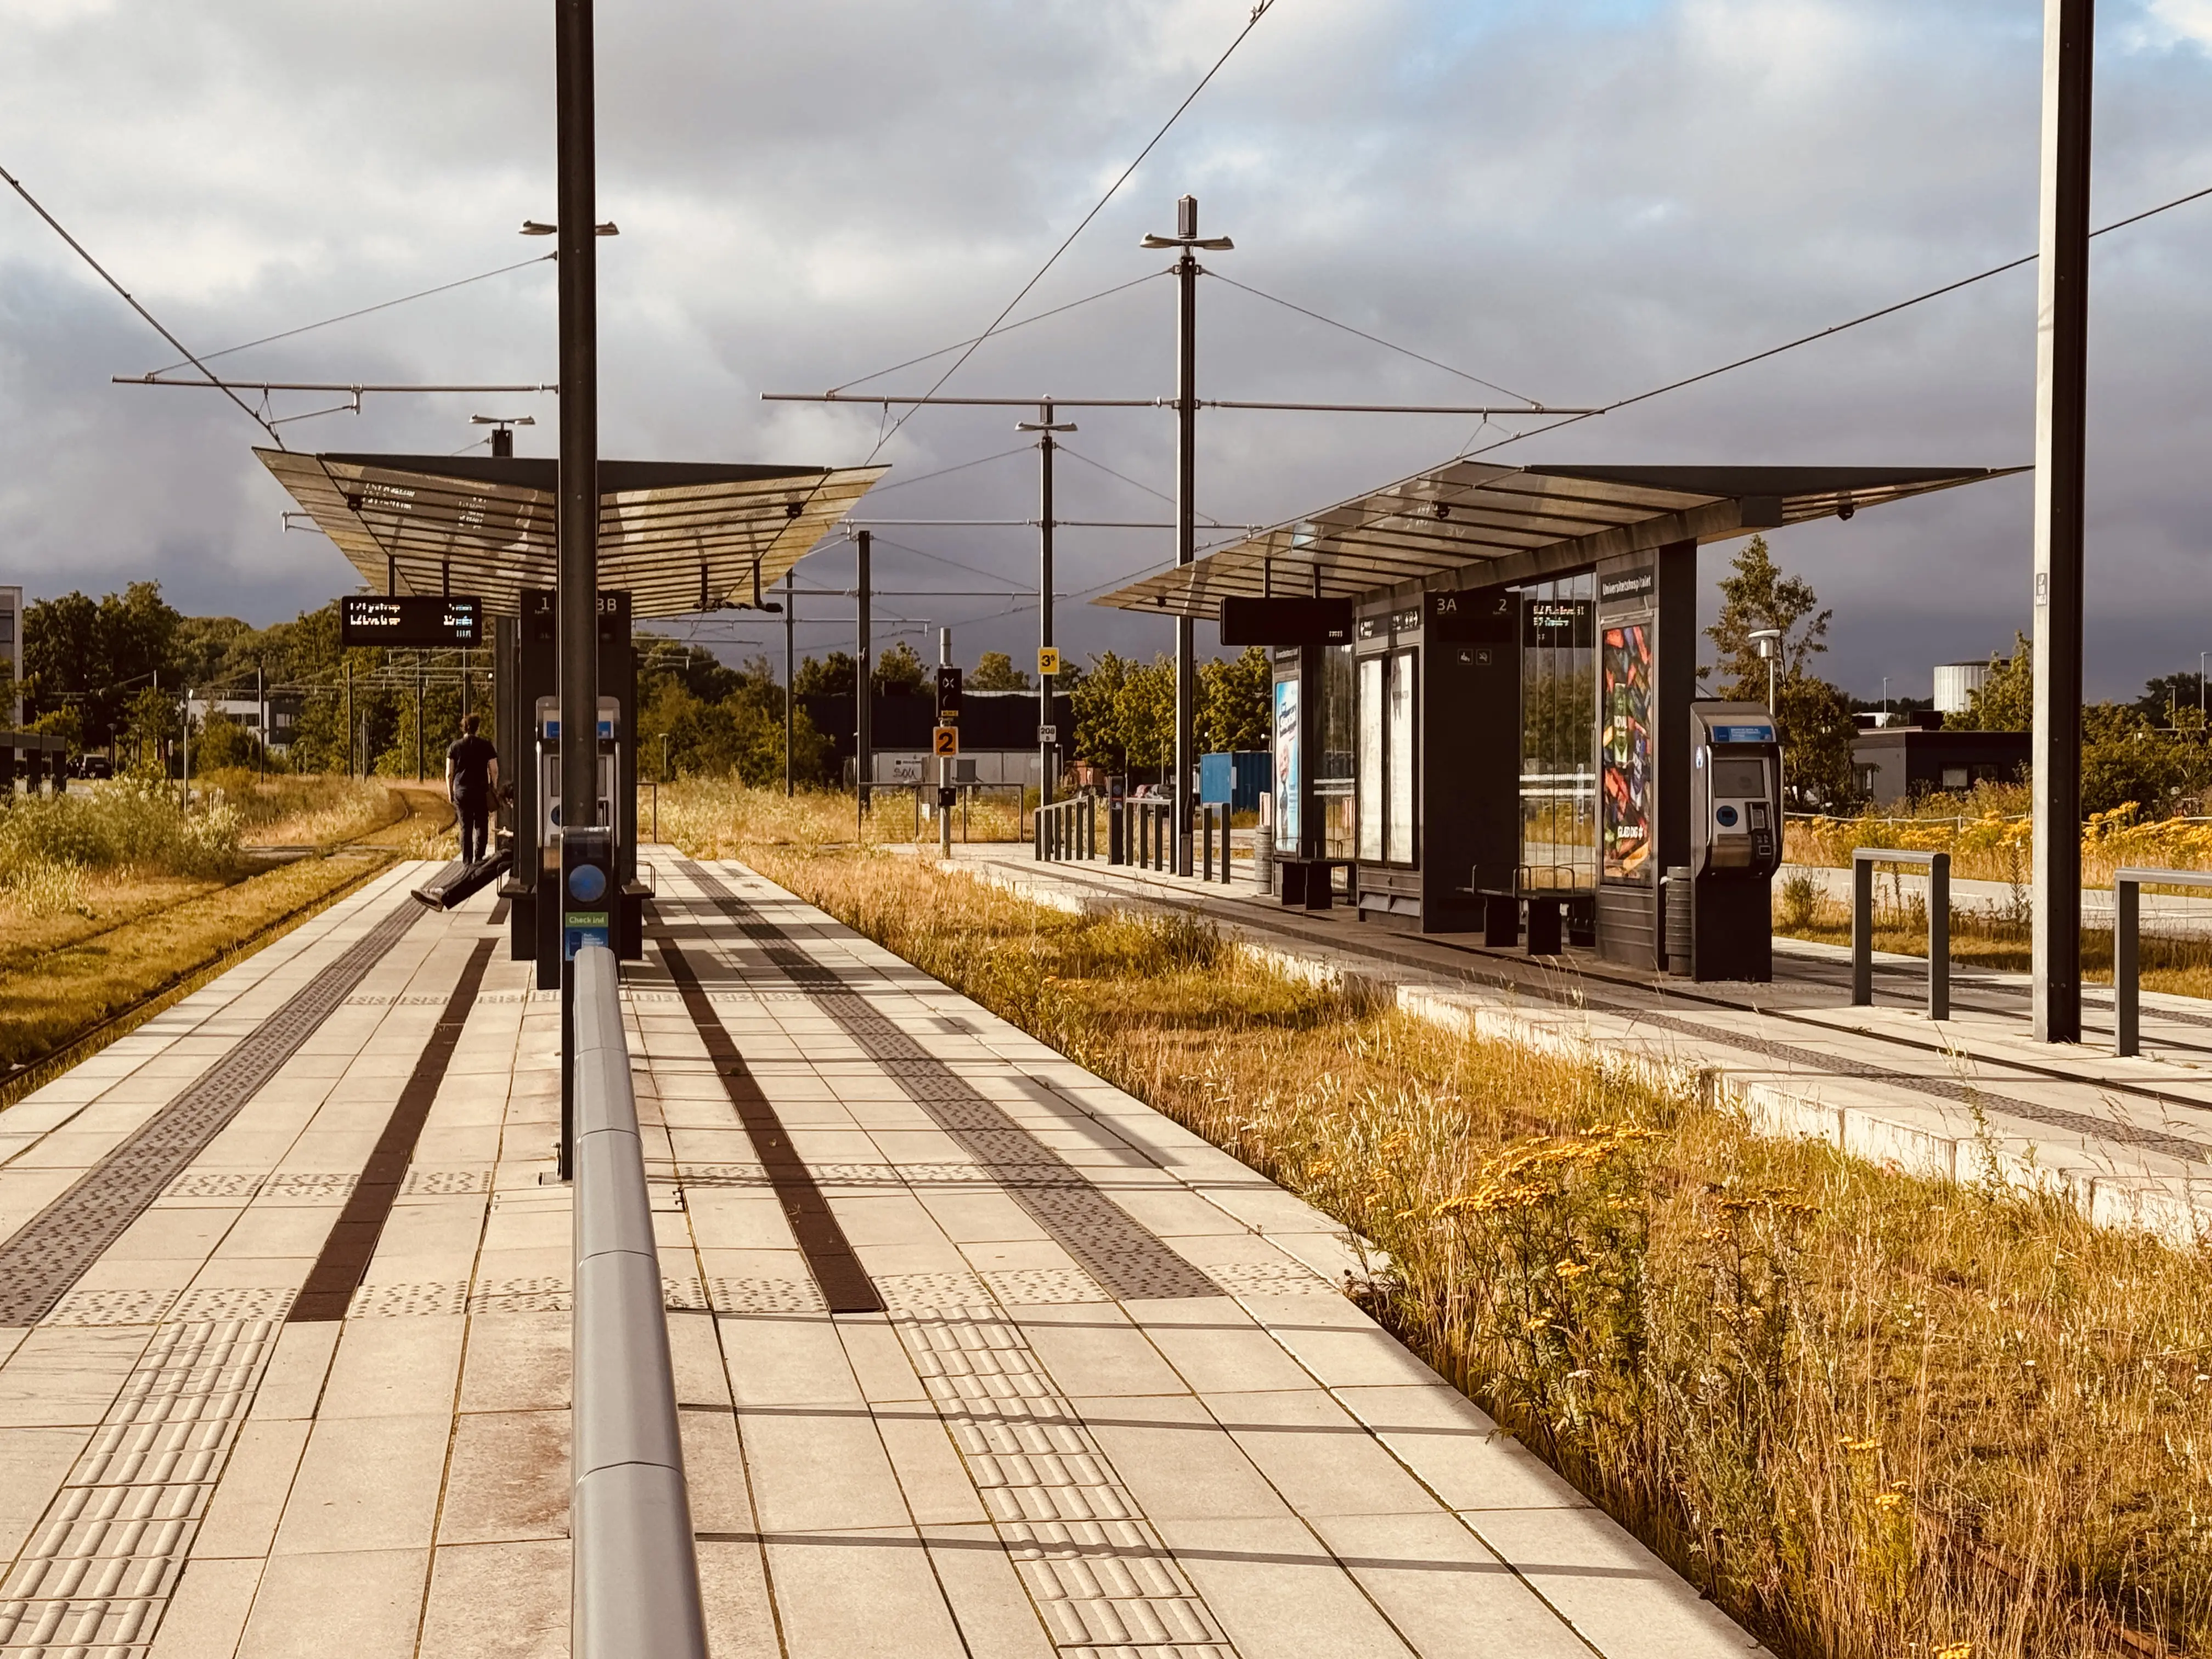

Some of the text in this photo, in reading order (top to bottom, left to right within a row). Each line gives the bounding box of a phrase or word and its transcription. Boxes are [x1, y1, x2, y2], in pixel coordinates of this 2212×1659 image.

[541, 597, 549, 610] 1
[1437, 599, 1457, 611] 3A
[1499, 599, 1507, 611] 2
[939, 732, 953, 752] 2
